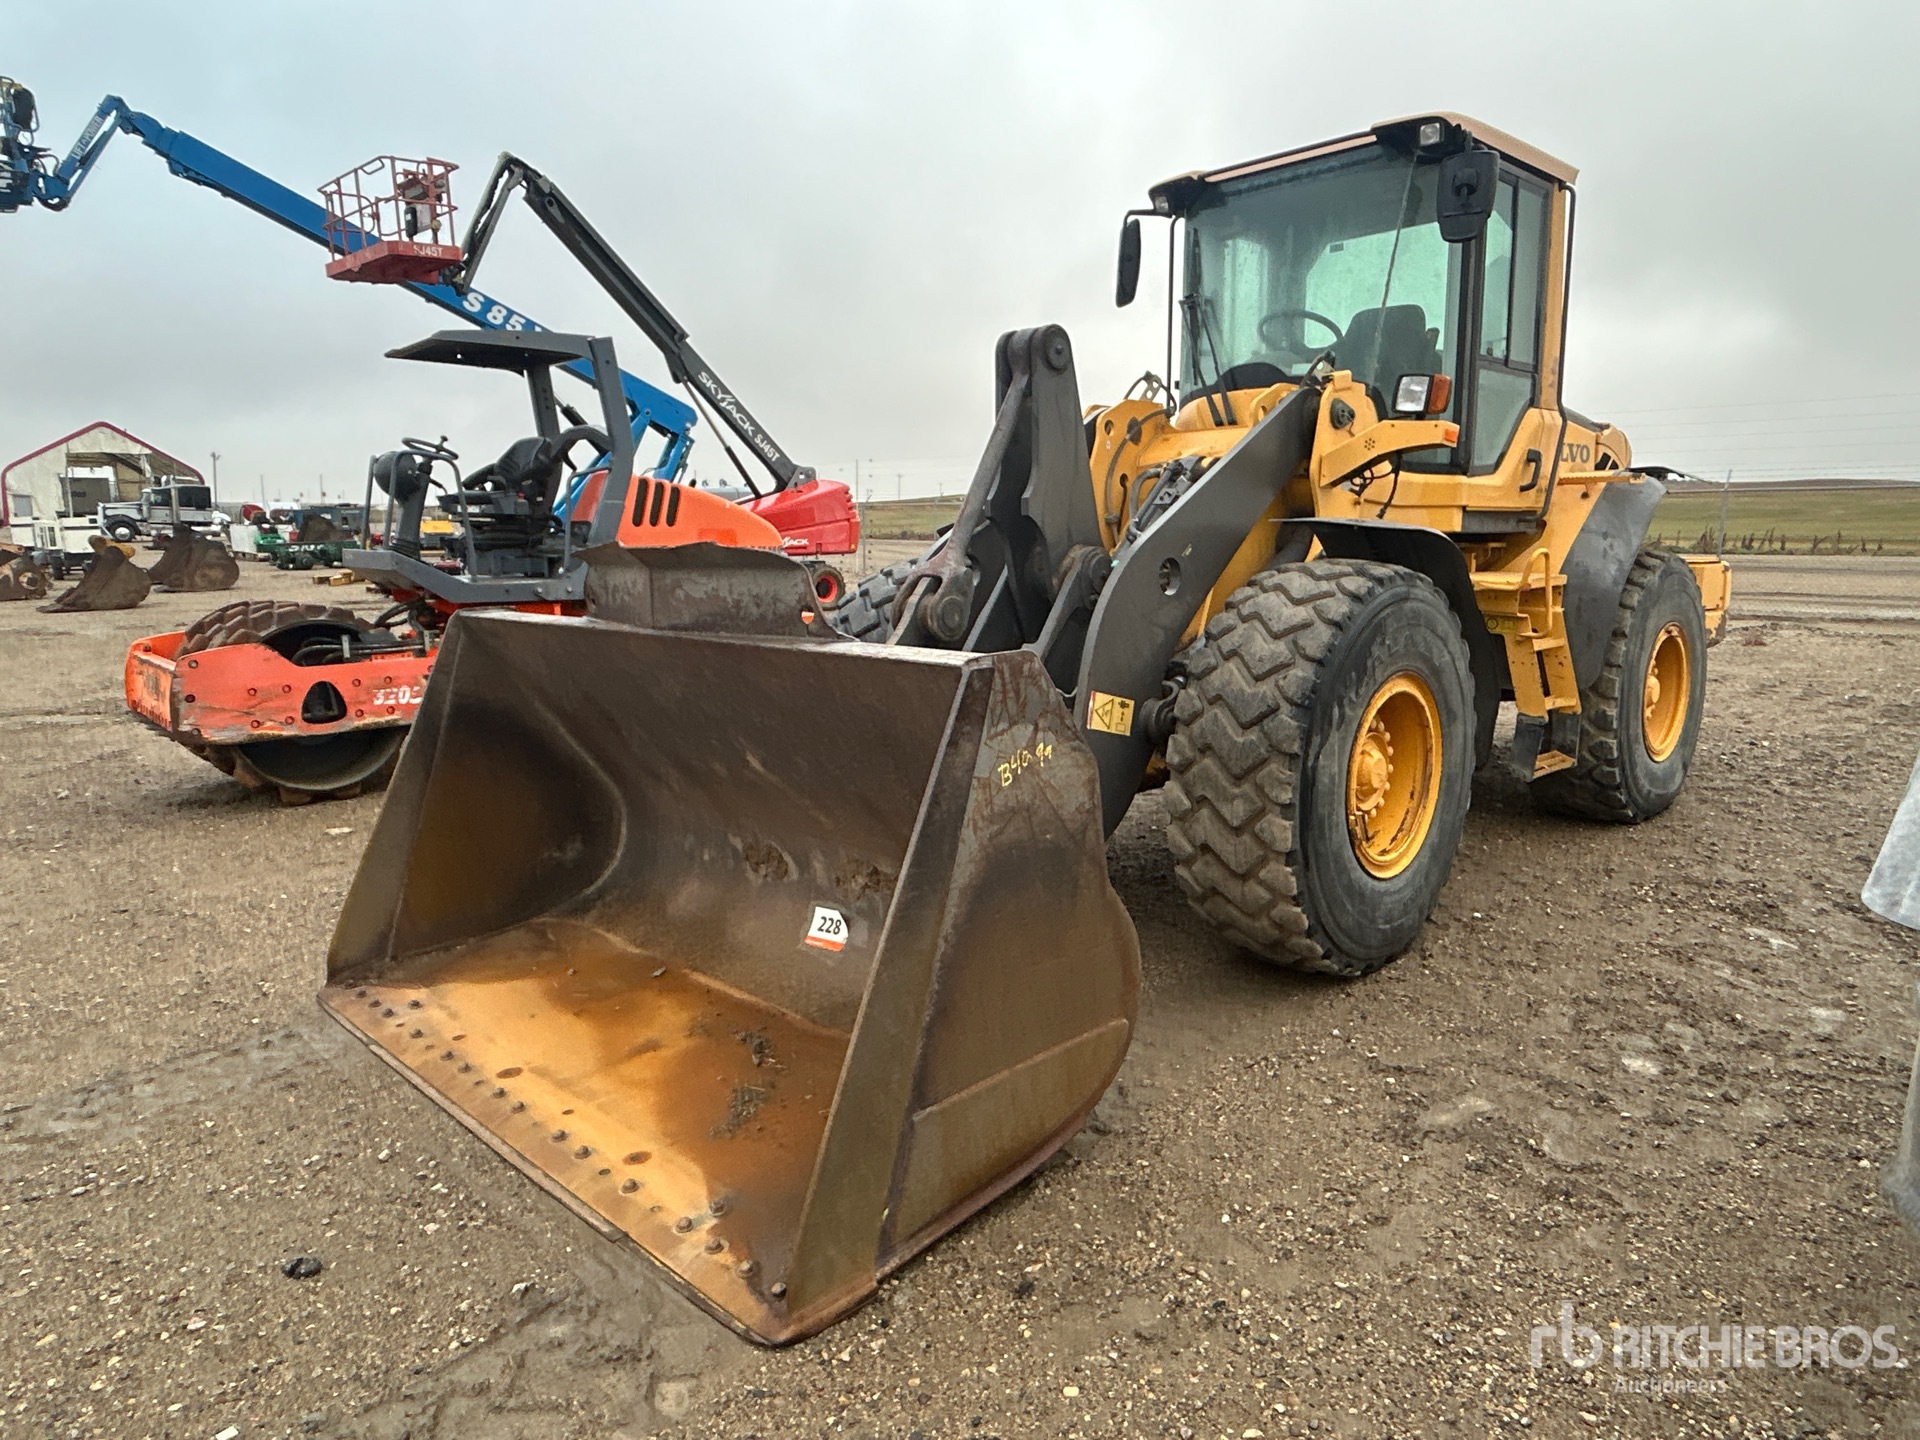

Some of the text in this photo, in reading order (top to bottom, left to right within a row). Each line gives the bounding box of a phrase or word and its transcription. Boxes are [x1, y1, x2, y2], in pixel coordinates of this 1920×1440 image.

[462, 291, 527, 331] S 85
[698, 371, 781, 462] SKYJACK SJ45T
[1560, 442, 1591, 464] LVO
[817, 915, 842, 935] 228
